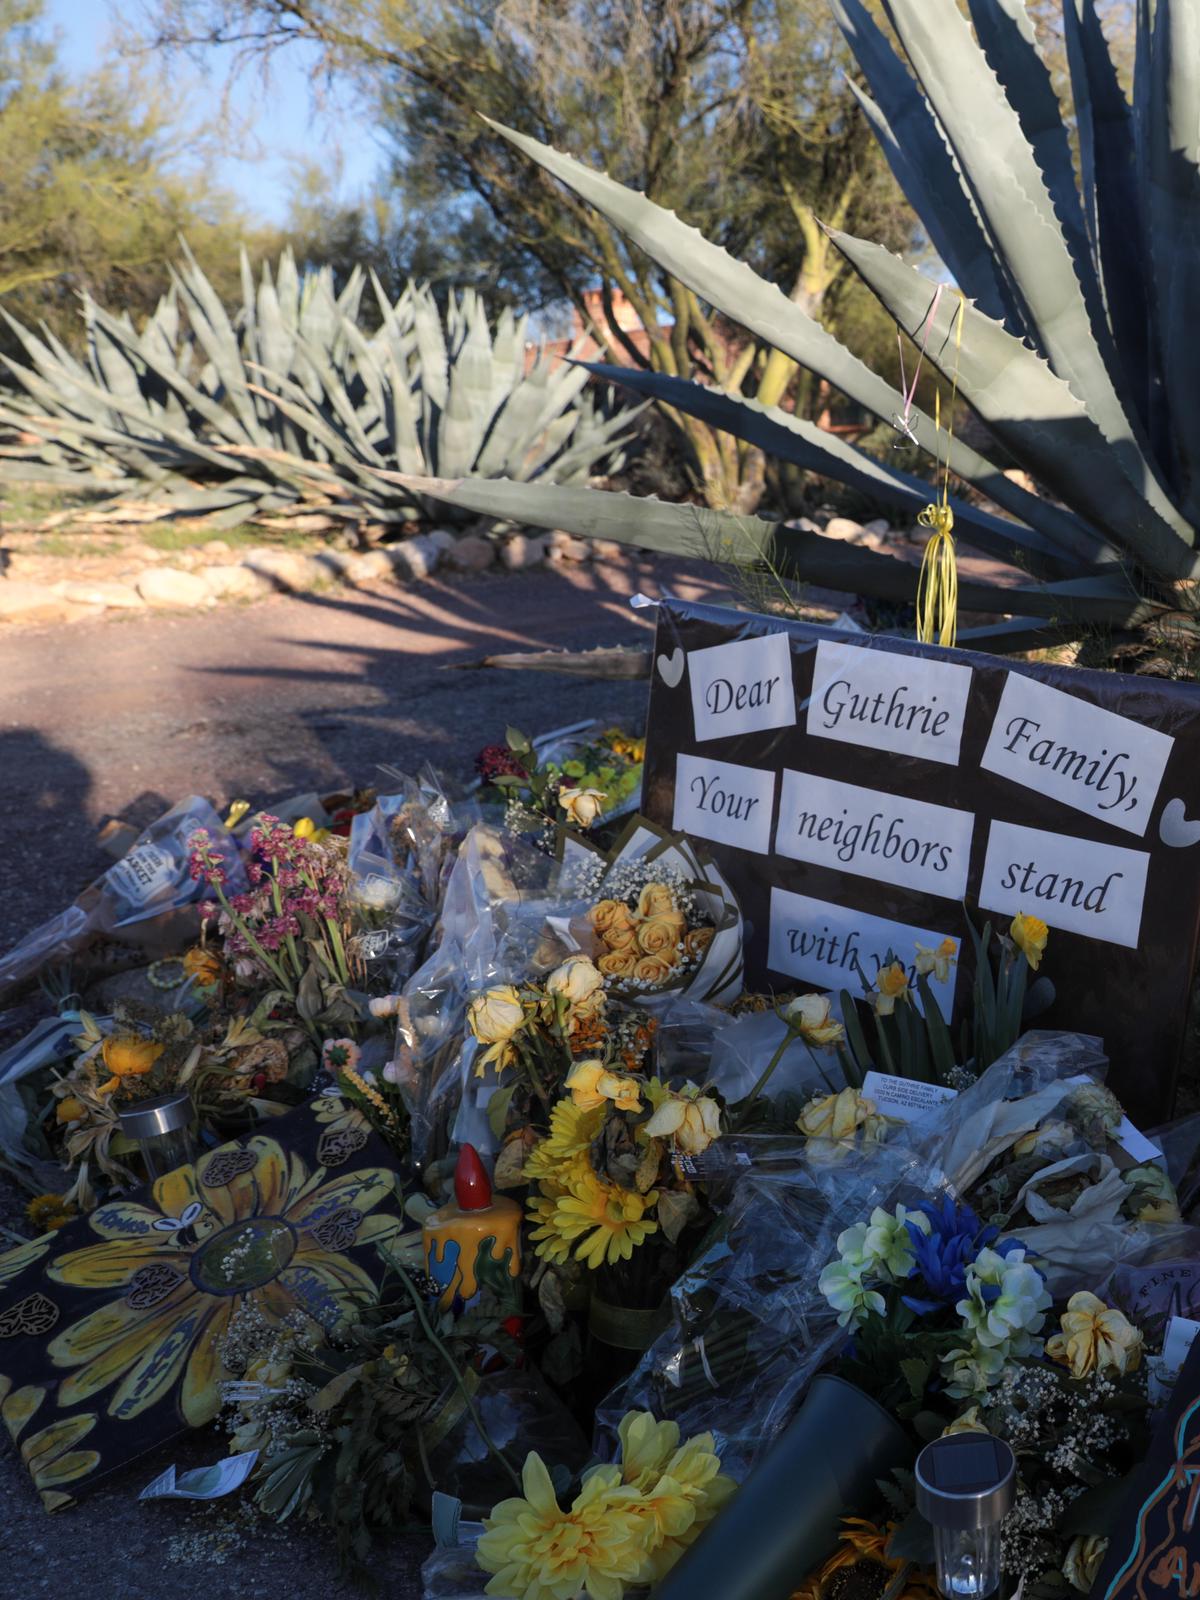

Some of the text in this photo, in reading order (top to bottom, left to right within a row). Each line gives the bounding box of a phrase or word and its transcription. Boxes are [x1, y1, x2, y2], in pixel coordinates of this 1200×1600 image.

[706, 671, 1139, 811] Dear Guthrie Family,
[690, 774, 1124, 915] Your neighbors stand
[787, 927, 862, 973] with
